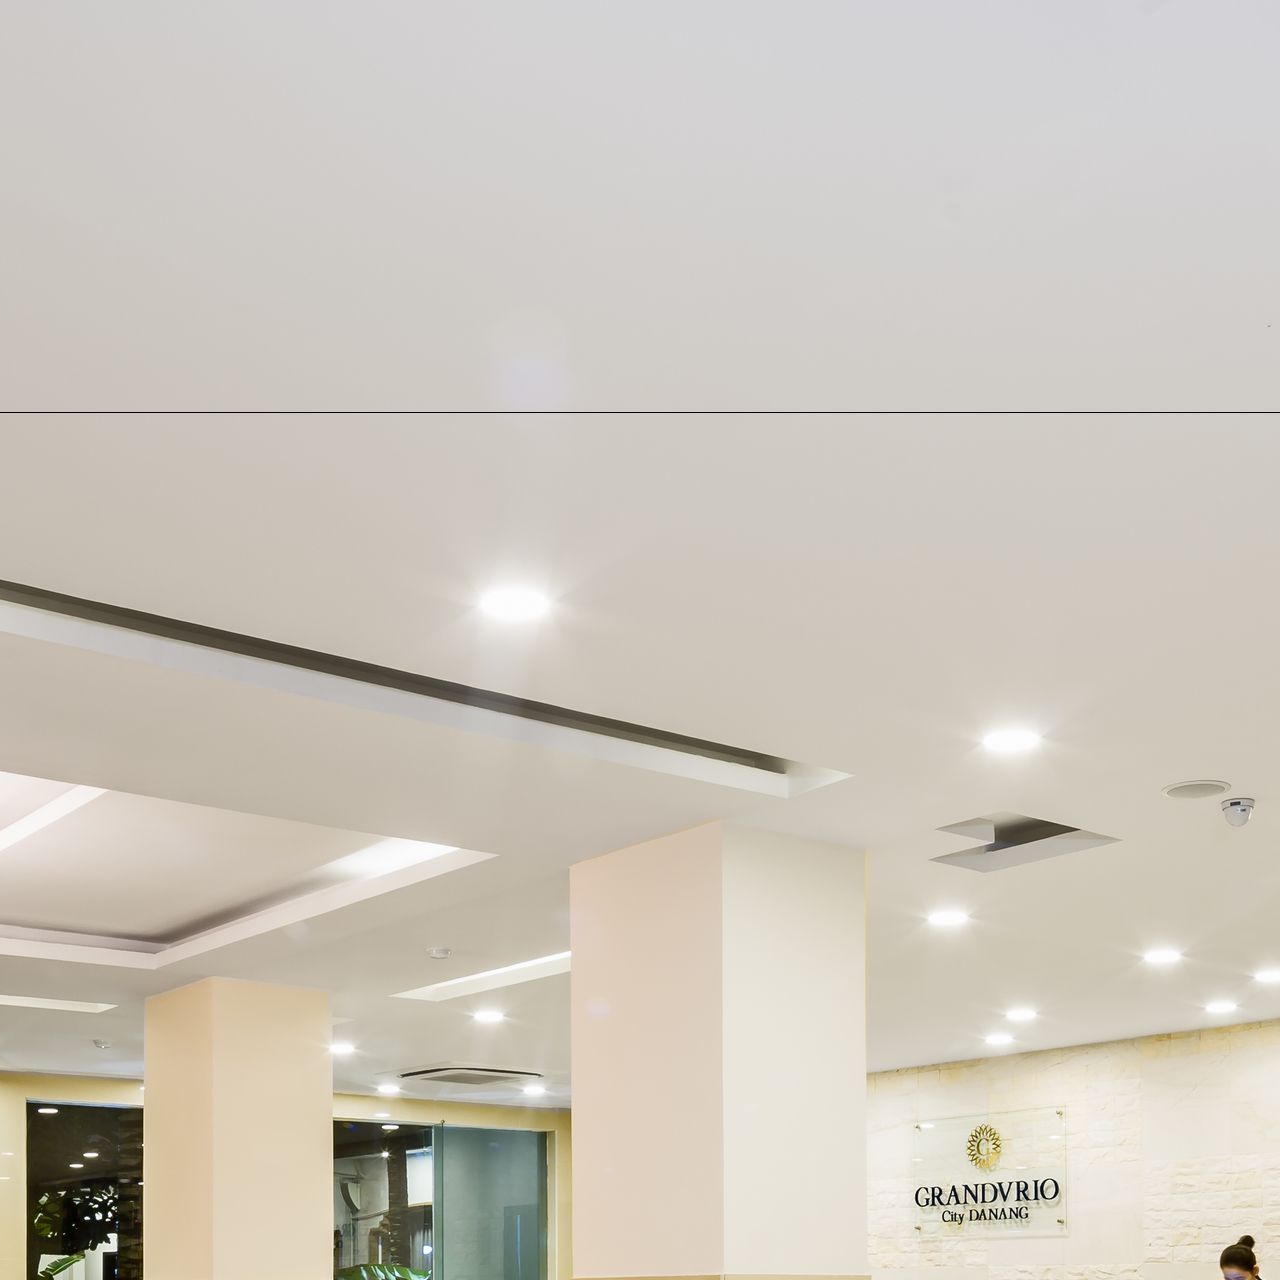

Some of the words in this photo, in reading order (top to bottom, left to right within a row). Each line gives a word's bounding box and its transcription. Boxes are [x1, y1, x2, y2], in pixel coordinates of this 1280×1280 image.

[914, 1178, 1059, 1207] GRANDVRIO
[942, 1210, 964, 1225] City
[969, 1207, 1029, 1221] DANANG
